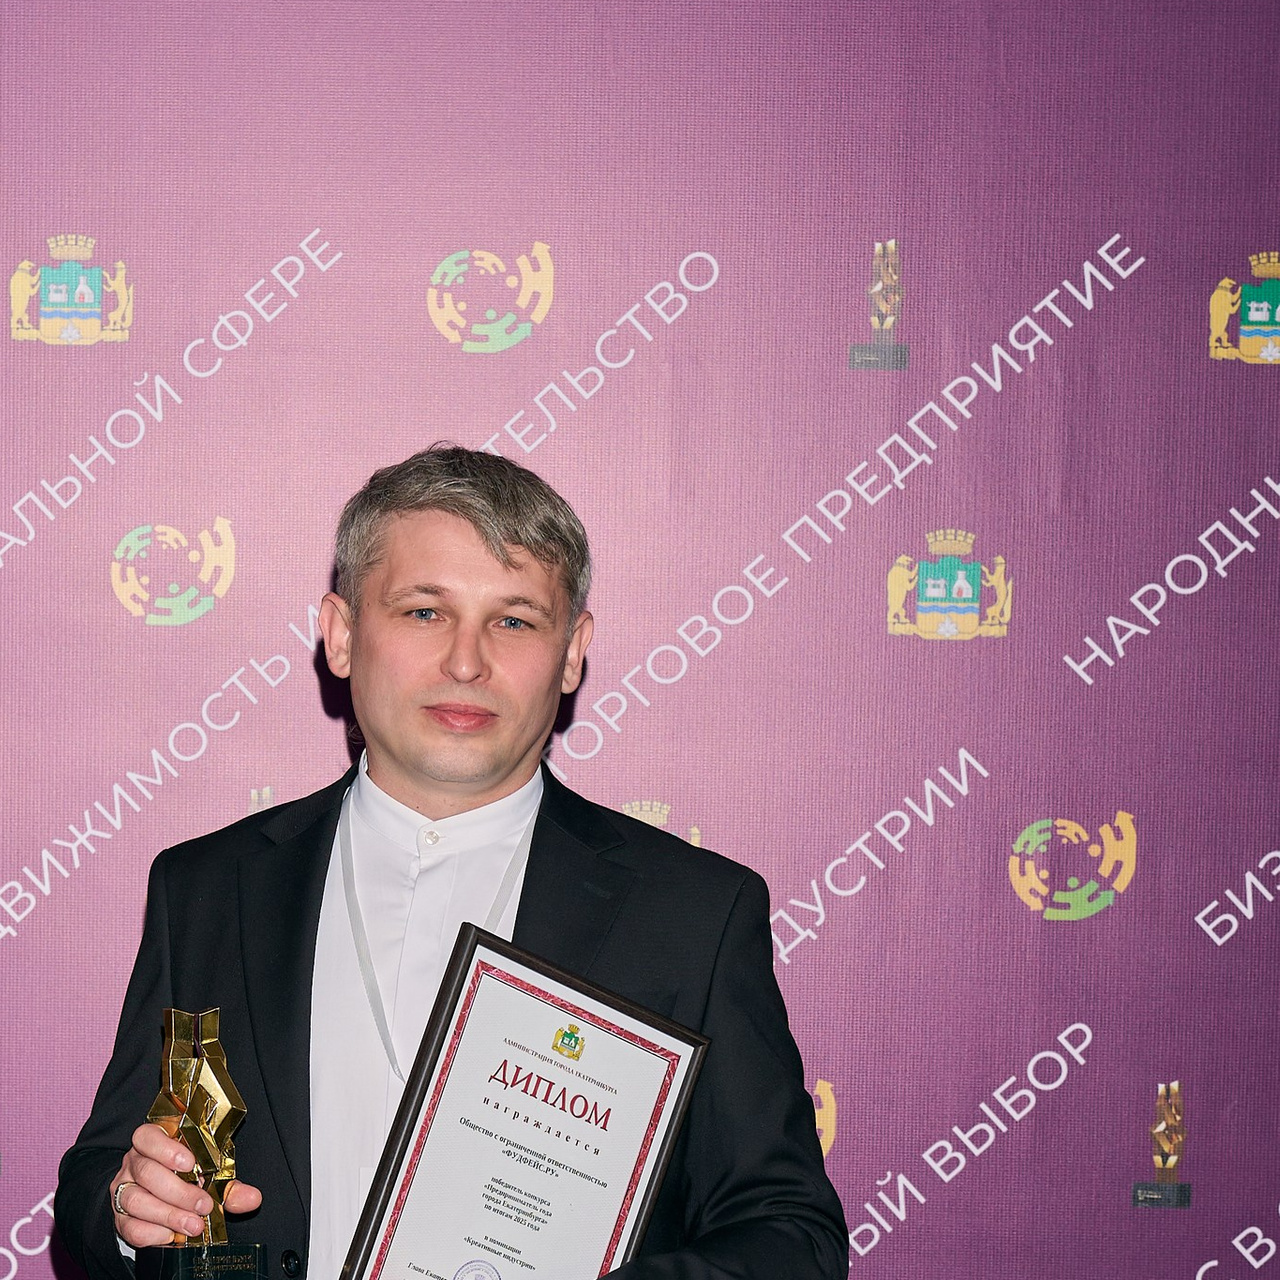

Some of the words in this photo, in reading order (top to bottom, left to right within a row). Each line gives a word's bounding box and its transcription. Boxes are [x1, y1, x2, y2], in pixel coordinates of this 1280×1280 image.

[184, 229, 342, 377] СФЕРЕ
[480, 252, 719, 454] ТЕЛЬСТВО
[541, 553, 789, 782] ТОРГОВОЕ
[782, 233, 1146, 562] ПРЕДПРИЯТИЕ
[770, 747, 989, 965] ДУСТРИИ
[488, 1059, 612, 1131] ДИПЛОМ
[503, 1037, 553, 1064] АДМИНИСТРАЦИЯ
[554, 1060, 574, 1075] ГОРОДА
[575, 1071, 618, 1095] ЕКАТЕРИНБУРГА
[459, 1116, 493, 1139] Общество
[499, 1136, 546, 1161] ограниченной
[547, 1155, 608, 1189] ответственностью
[483, 1097, 600, 1156] награждается
[848, 1171, 926, 1268] ЫЙ
[921, 1022, 1093, 1183] ВЫБОР
[491, 1176, 523, 1195] победитель
[524, 1191, 551, 1207] конкурса
[502, 1149, 559, 1178] «ФУДФЕЙС.РУ»
[482, 1193, 502, 1207] города
[502, 1201, 548, 1225] Екатеринбурга»
[484, 1184, 539, 1211] «Предприниматель
[539, 1208, 553, 1217] года
[492, 1208, 513, 1221] итогам
[513, 1215, 526, 1226] 2025
[527, 1222, 540, 1232] года
[464, 1236, 502, 1256] «Креативные
[503, 1252, 536, 1271] индустрии»
[489, 1238, 522, 1255] номинации
[1231, 1226, 1277, 1270] В
